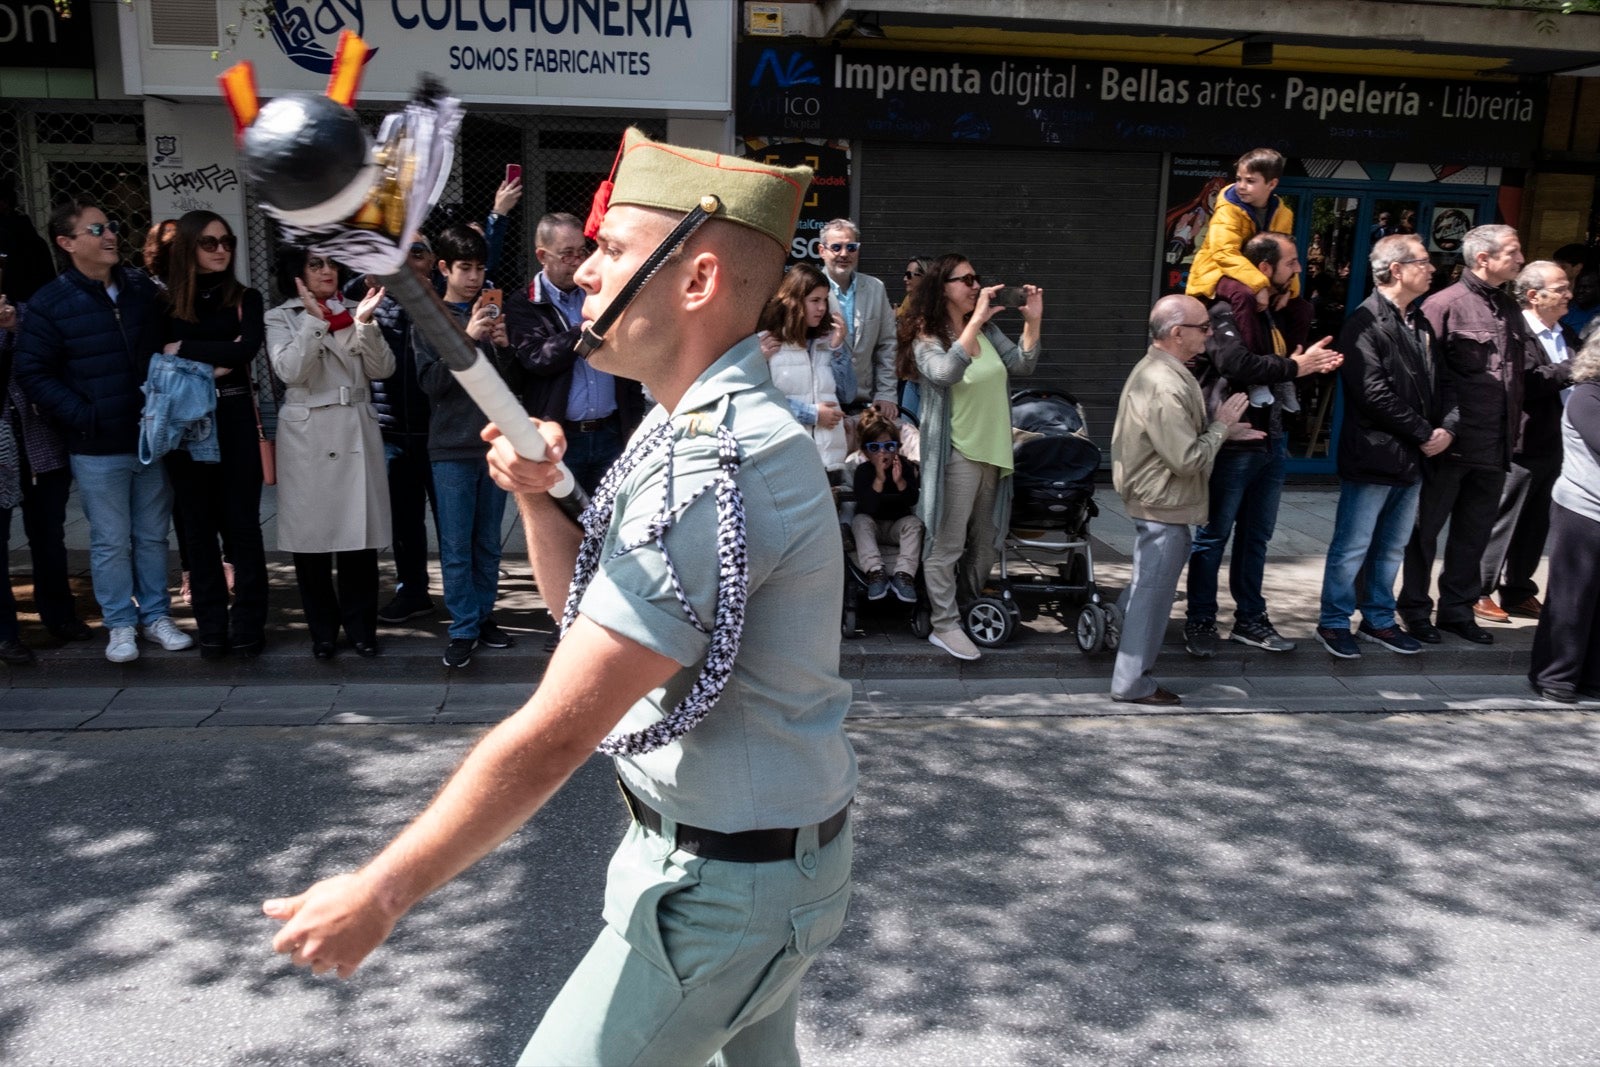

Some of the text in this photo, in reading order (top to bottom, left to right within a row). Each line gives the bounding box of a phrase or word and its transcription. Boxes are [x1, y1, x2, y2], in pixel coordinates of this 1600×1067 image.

[449, 46, 650, 76] SOMOS FABRICANTES
[834, 54, 1534, 122] Imprenta digital Bellas artes Papelería Libreria
[812, 175, 846, 187] Kodak
